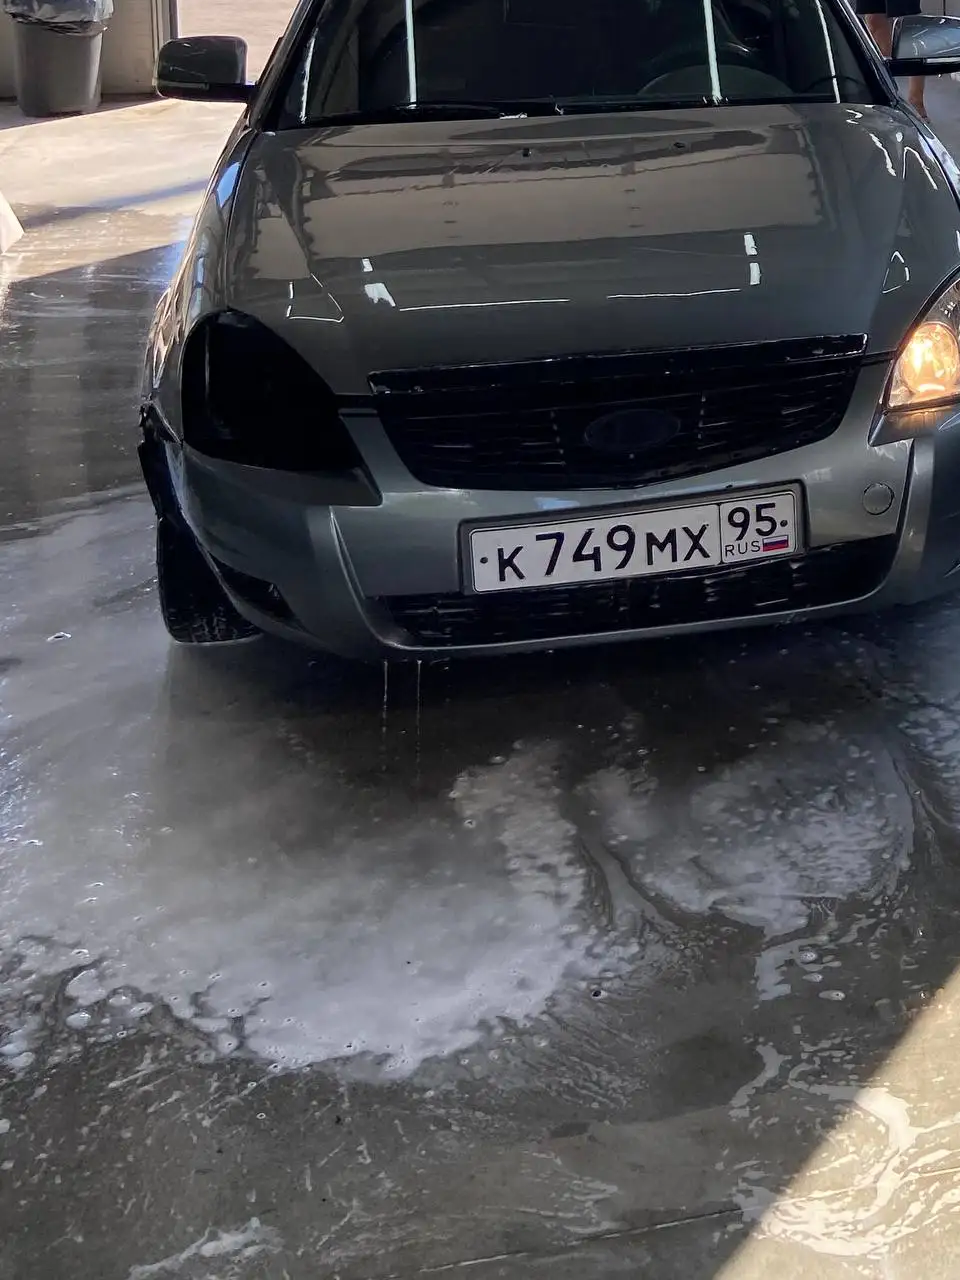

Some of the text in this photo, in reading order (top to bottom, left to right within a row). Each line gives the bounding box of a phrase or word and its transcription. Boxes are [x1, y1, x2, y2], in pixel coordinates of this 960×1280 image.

[497, 502, 777, 582] К749МХ 95
[724, 540, 761, 557] RUS
